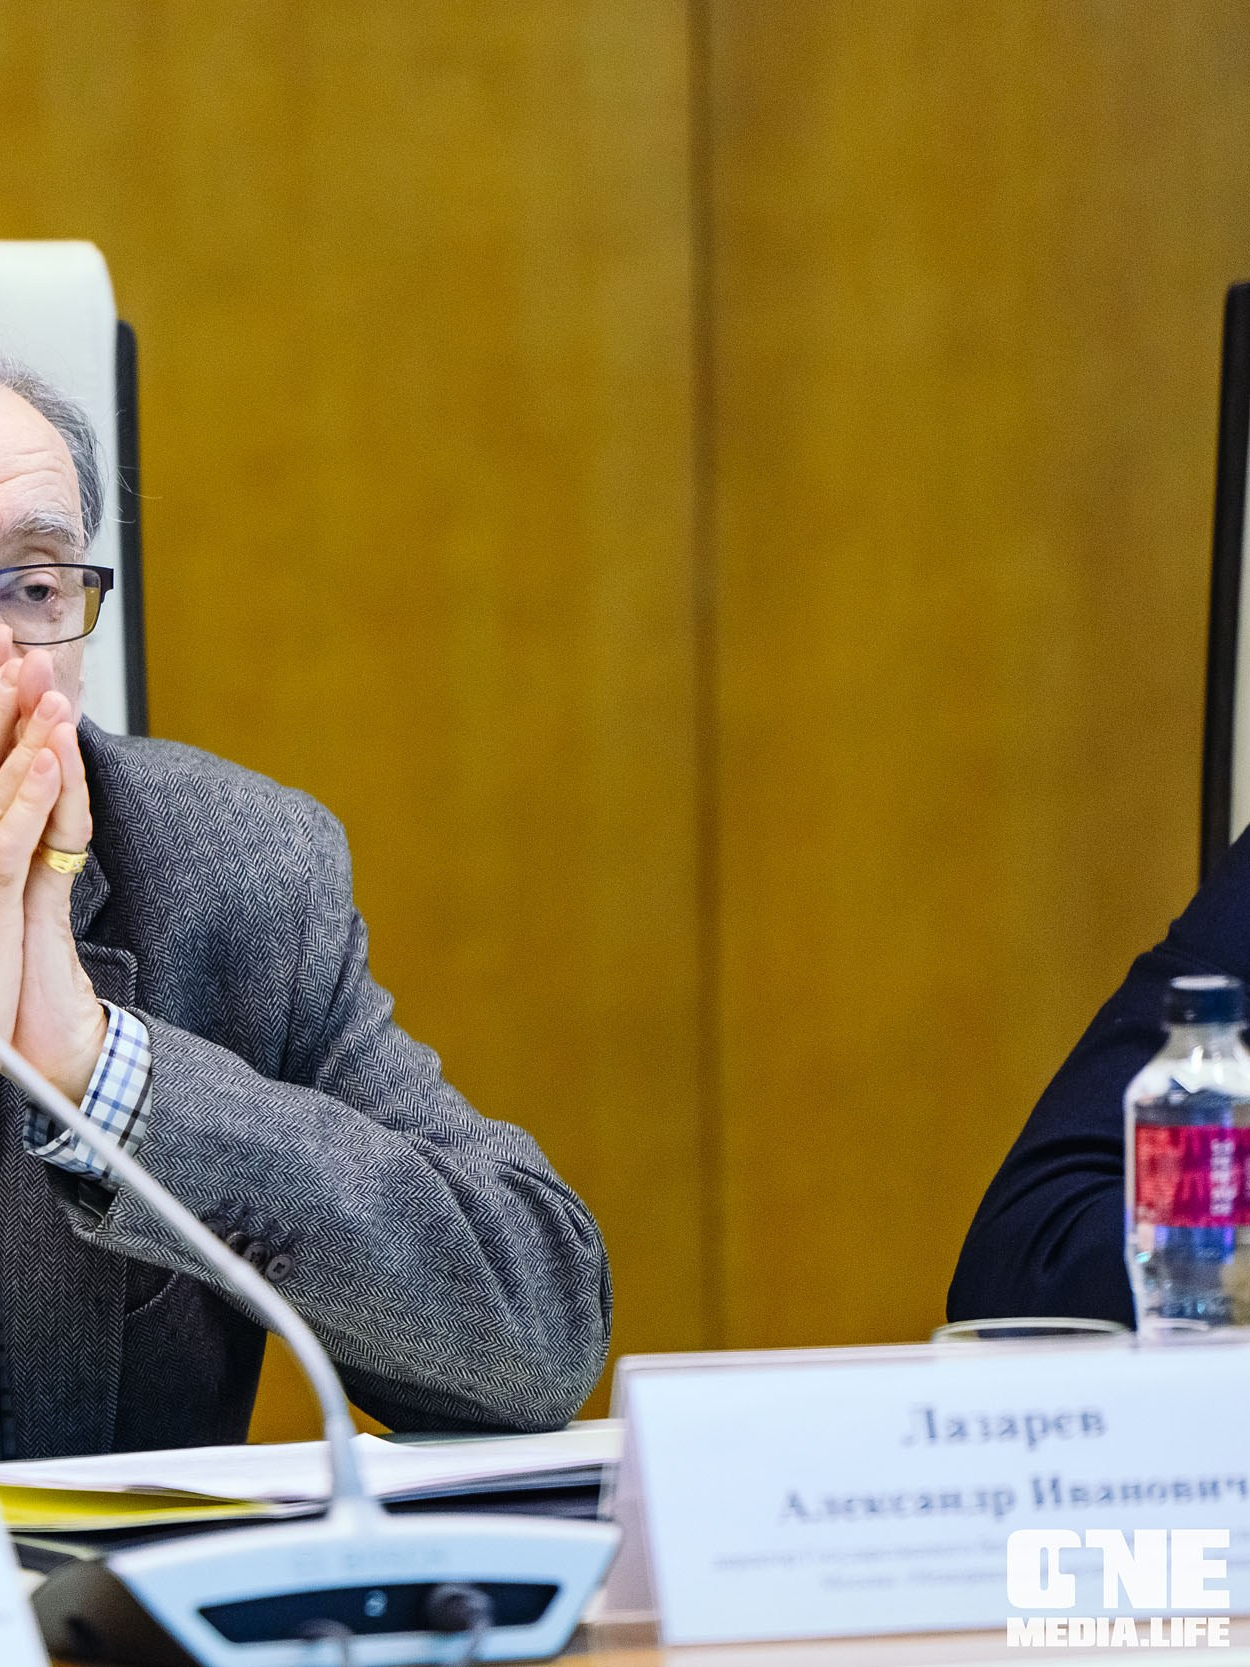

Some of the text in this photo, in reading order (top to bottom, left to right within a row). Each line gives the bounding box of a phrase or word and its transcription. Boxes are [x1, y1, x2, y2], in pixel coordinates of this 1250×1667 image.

[903, 1405, 1105, 1450] Лазарев
[782, 1473, 1250, 1522] Александр Иванович
